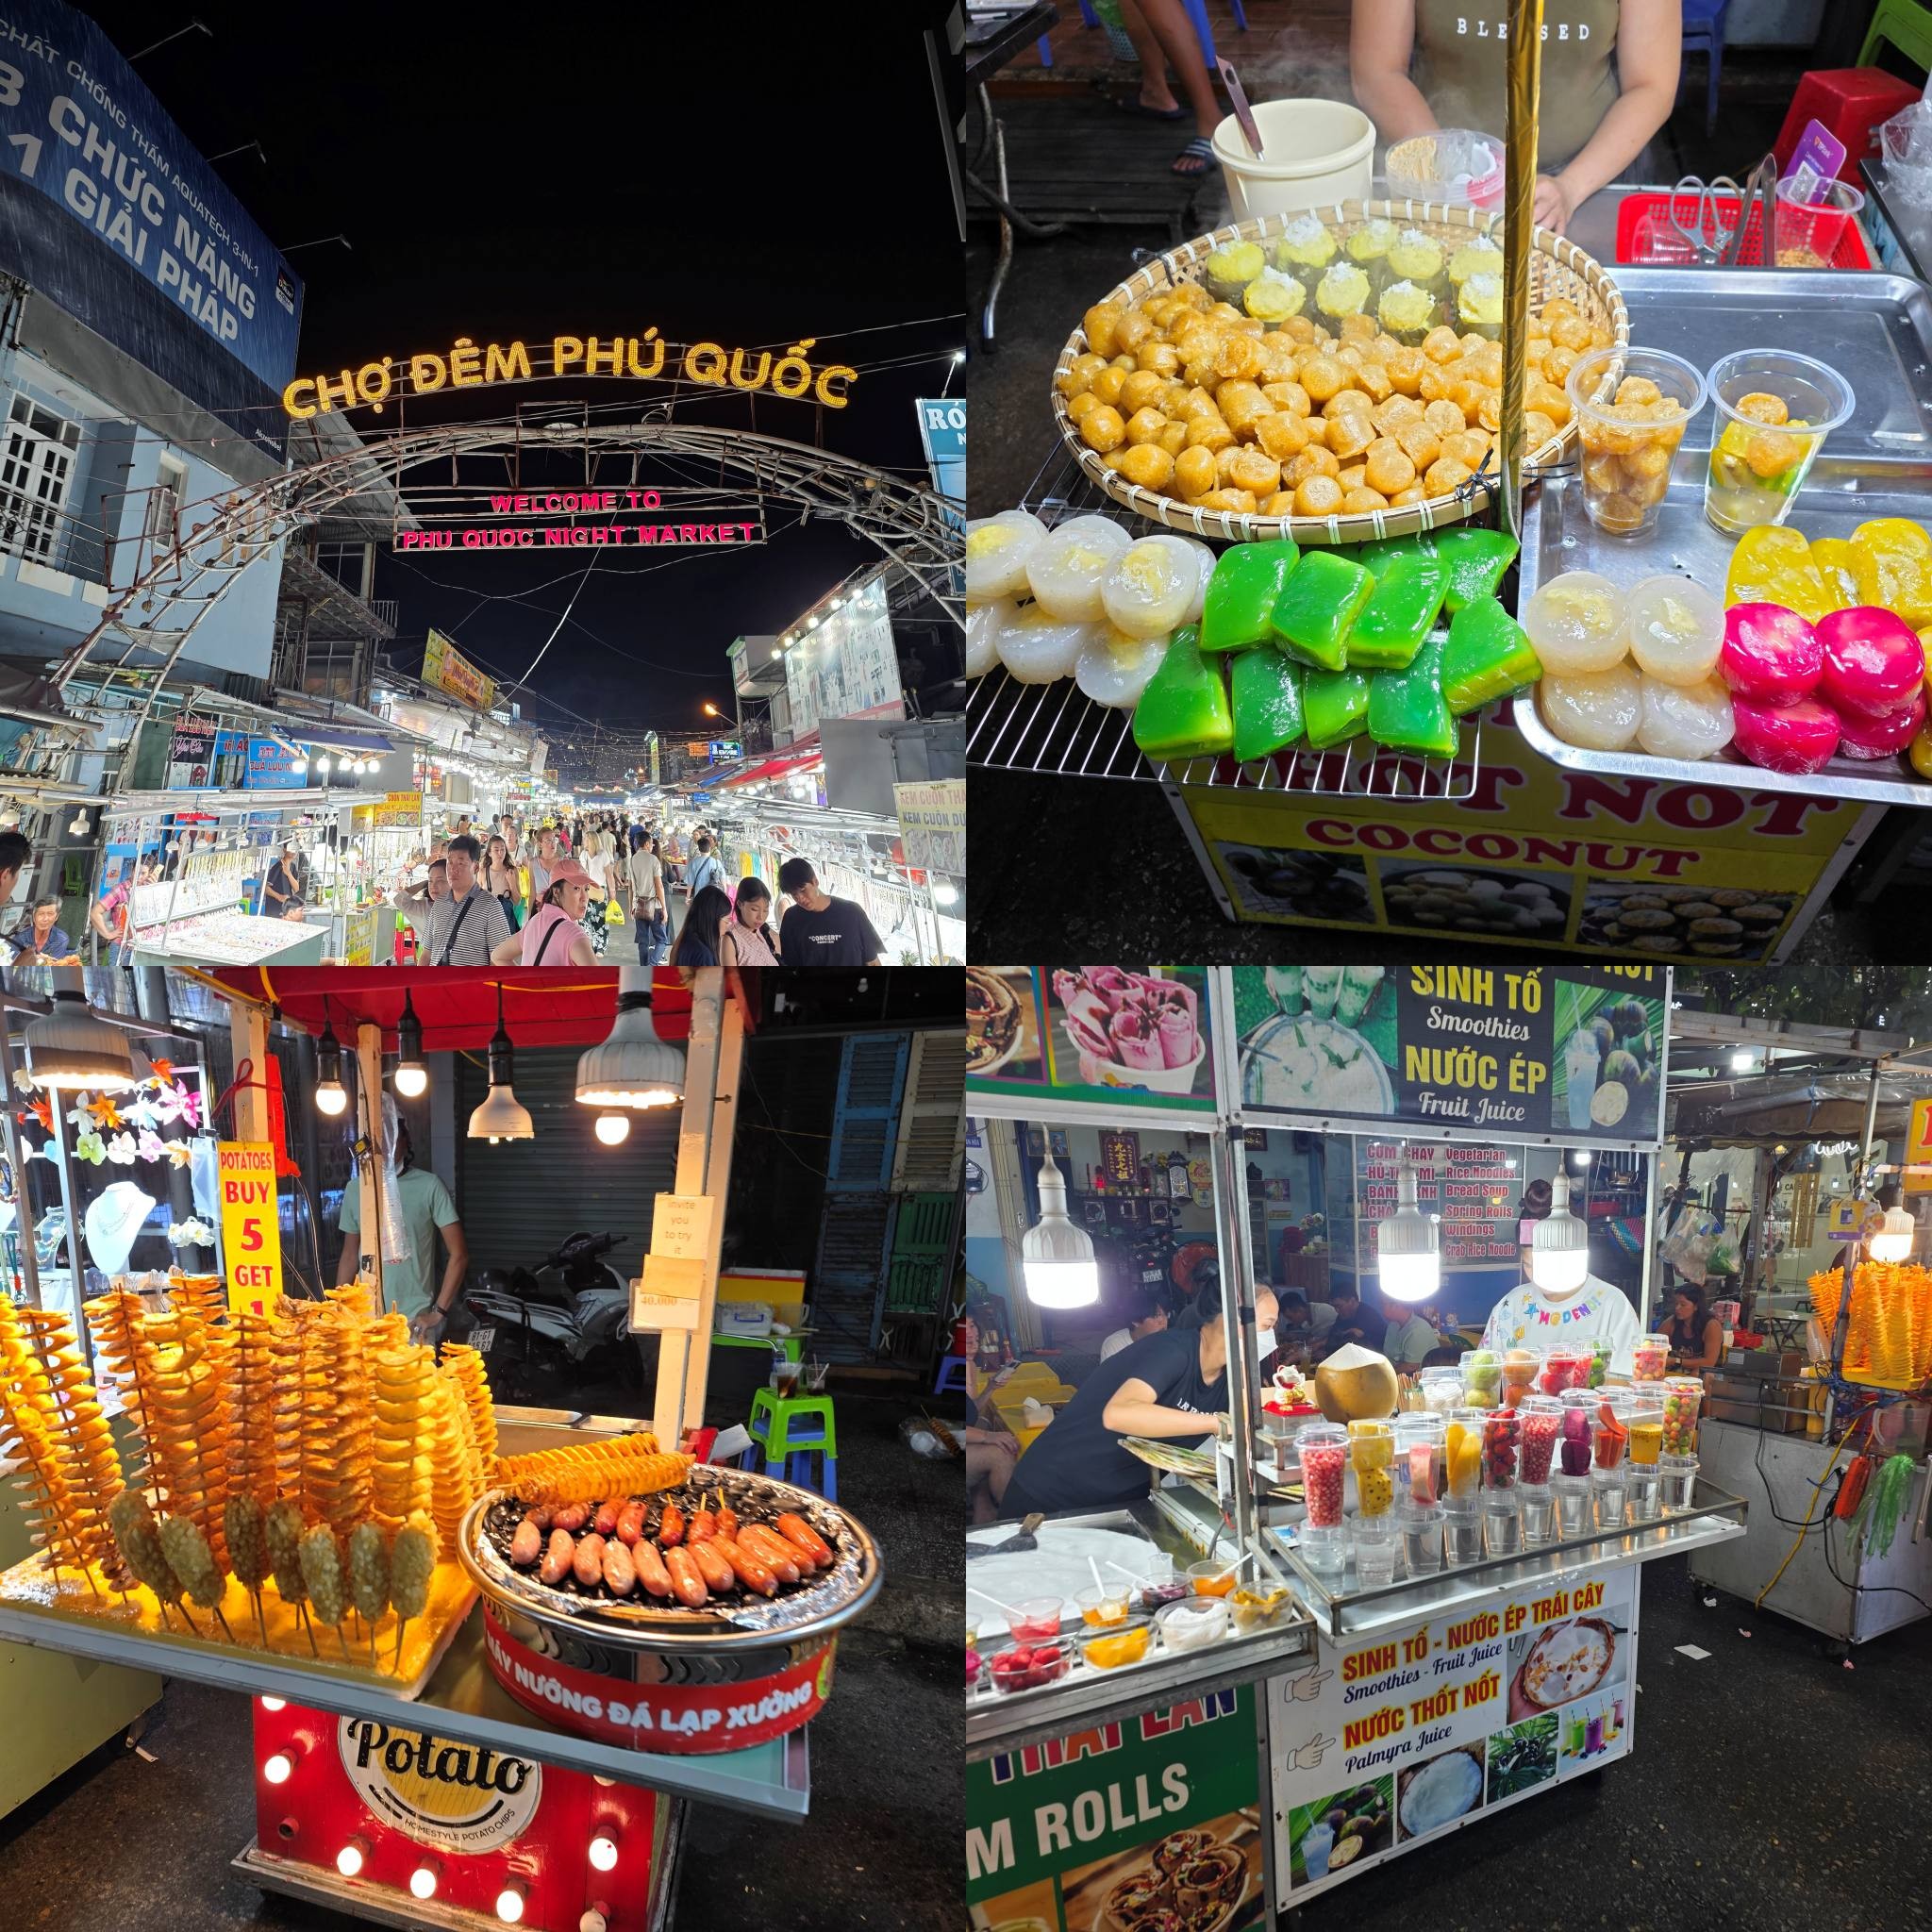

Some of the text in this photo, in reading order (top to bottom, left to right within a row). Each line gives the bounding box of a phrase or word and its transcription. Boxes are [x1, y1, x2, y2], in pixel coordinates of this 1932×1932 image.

[1457, 18, 1590, 41] BLESED
[67, 60, 126, 128] CHỐNG
[172, 174, 230, 246] AQUATECH
[232, 241, 259, 277] 3-IN-1
[49, 95, 165, 226] CHỨC
[175, 214, 256, 320] NĂNG
[8, 133, 239, 341] 1 GIẢI PHÁP
[283, 326, 858, 419] CHỢ ĐÊM PHÚ QUỐC
[491, 491, 662, 514] WELCOME TO
[403, 523, 756, 550] PHU QUOC NIGHT MARKET
[903, 811, 921, 824] KEM
[1560, 774, 1840, 836] NOT
[1306, 819, 1702, 877] COCONUT
[1411, 966, 1543, 1014] SINH TỐ
[1426, 1005, 1531, 1041] Smoothies
[1406, 1044, 1547, 1095] NƯỚC ÉP
[1418, 1091, 1526, 1124] Fruit Juice
[220, 1151, 273, 1171] POTATOES
[1445, 1147, 1507, 1162] Vegetarian
[1446, 1166, 1516, 1179] Rice Noodles
[225, 1181, 271, 1204] BUY
[1446, 1183, 1509, 1198] Bread Soup
[671, 1217, 690, 1225] you
[1445, 1204, 1513, 1219] Spring Rolls
[241, 1218, 263, 1251] 5
[665, 1231, 675, 1240] to
[1445, 1223, 1495, 1237] Windings
[1468, 1243, 1486, 1257] Rice
[235, 1264, 273, 1287] GET
[1341, 1645, 1397, 1683] SINH
[1403, 1623, 1429, 1662] TỐ
[1447, 1613, 1500, 1654] NƯỚC
[1504, 1602, 1527, 1634] ÉP
[1532, 1590, 1569, 1624] TRÁI
[1574, 1581, 1606, 1611] CÂY
[1343, 1668, 1420, 1704] Smoothies
[1432, 1654, 1466, 1677] Fruit
[1468, 1641, 1503, 1668] Juice
[515, 1663, 603, 1718] NƯỚNG
[607, 1701, 653, 1730] ĐÁ
[660, 1708, 722, 1737] LẠP
[1343, 1667, 1502, 1751] NƯỚC THỐT NỐT
[347, 1718, 533, 1794] Potato
[1345, 1723, 1453, 1774] Palmyra Juice
[461, 1825, 496, 1841] POTATO
[494, 1807, 516, 1830] CHIPS
[1034, 1762, 1191, 1857] ROLLS
